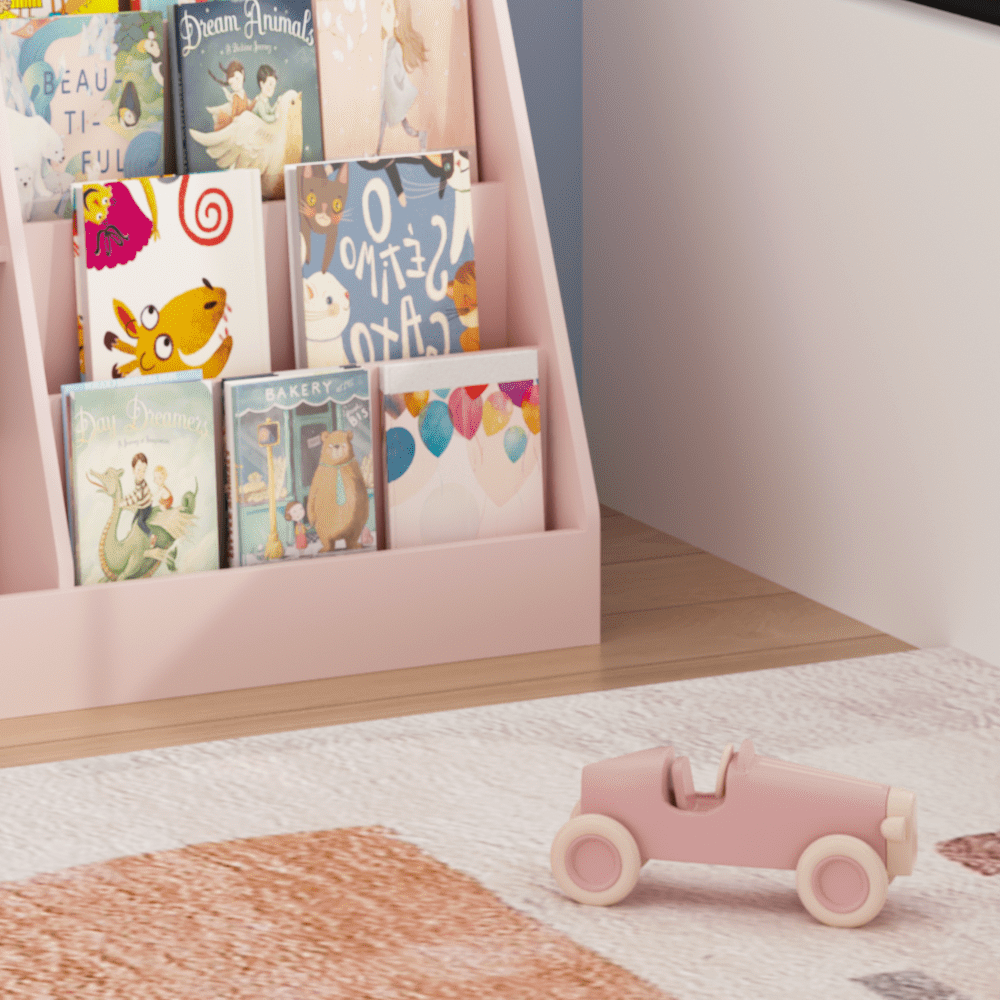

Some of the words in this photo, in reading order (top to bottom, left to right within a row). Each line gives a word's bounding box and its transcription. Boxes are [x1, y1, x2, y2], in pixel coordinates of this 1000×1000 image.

[179, 9, 242, 58] Dream
[43, 67, 123, 96] BEAU-
[64, 110, 101, 135] TI-
[81, 148, 124, 175] FUL
[264, 380, 333, 402] BAKERY
[74, 405, 117, 444] Day
